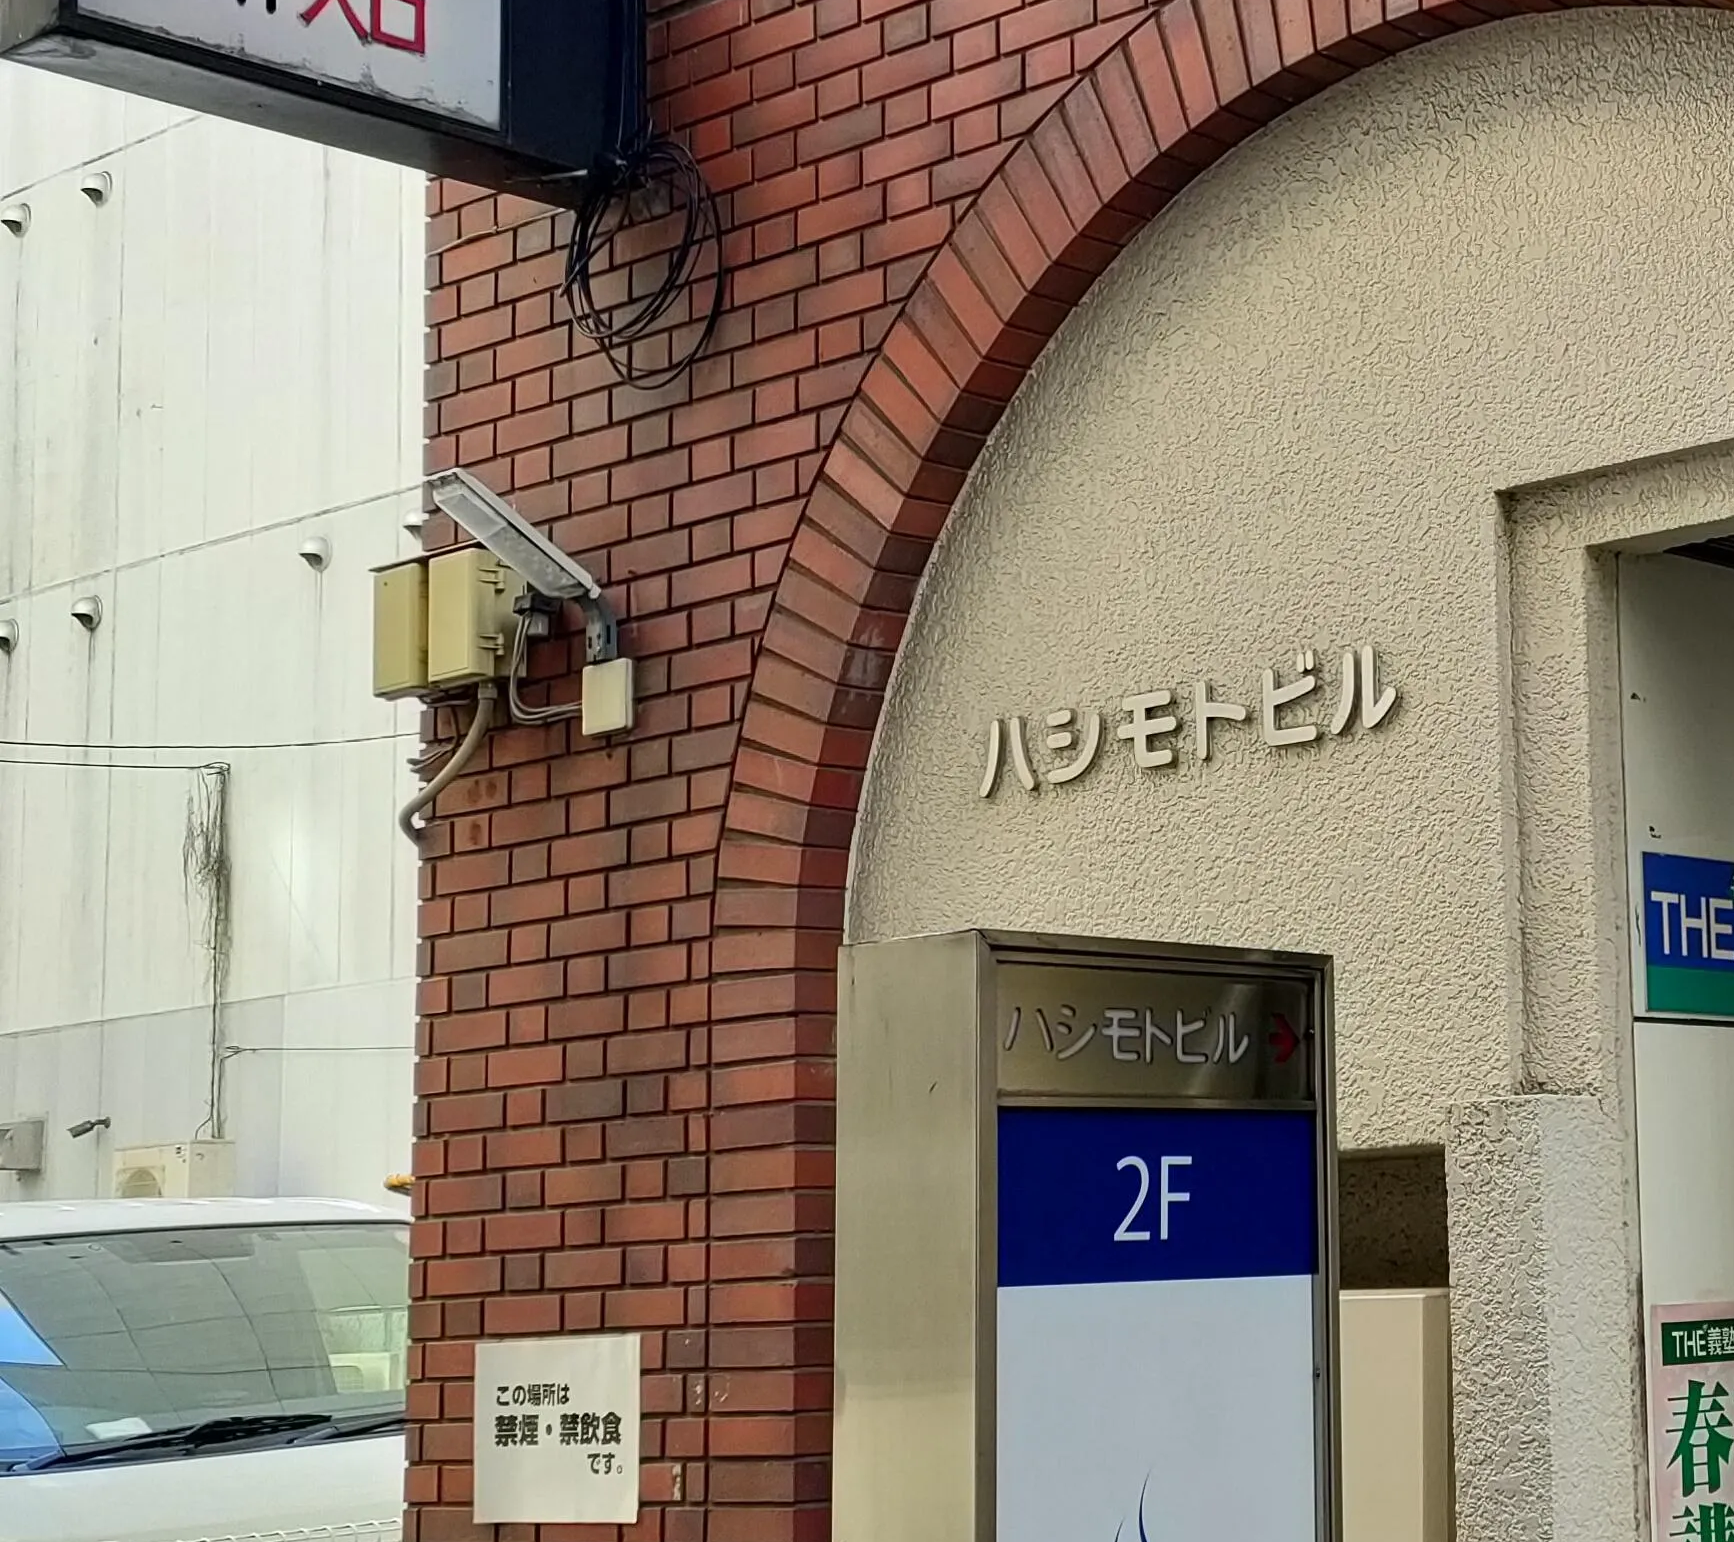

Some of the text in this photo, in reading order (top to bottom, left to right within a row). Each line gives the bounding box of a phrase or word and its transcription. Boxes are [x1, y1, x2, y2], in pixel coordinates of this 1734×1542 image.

[979, 644, 1398, 799] ハシモトビル
[1003, 1002, 1250, 1066] ハシモトビル
[1113, 1154, 1193, 1242] 2F
[495, 1382, 571, 1408] この場所は
[493, 1411, 623, 1448] 禁煙・禁飲食
[586, 1451, 625, 1475] です。
